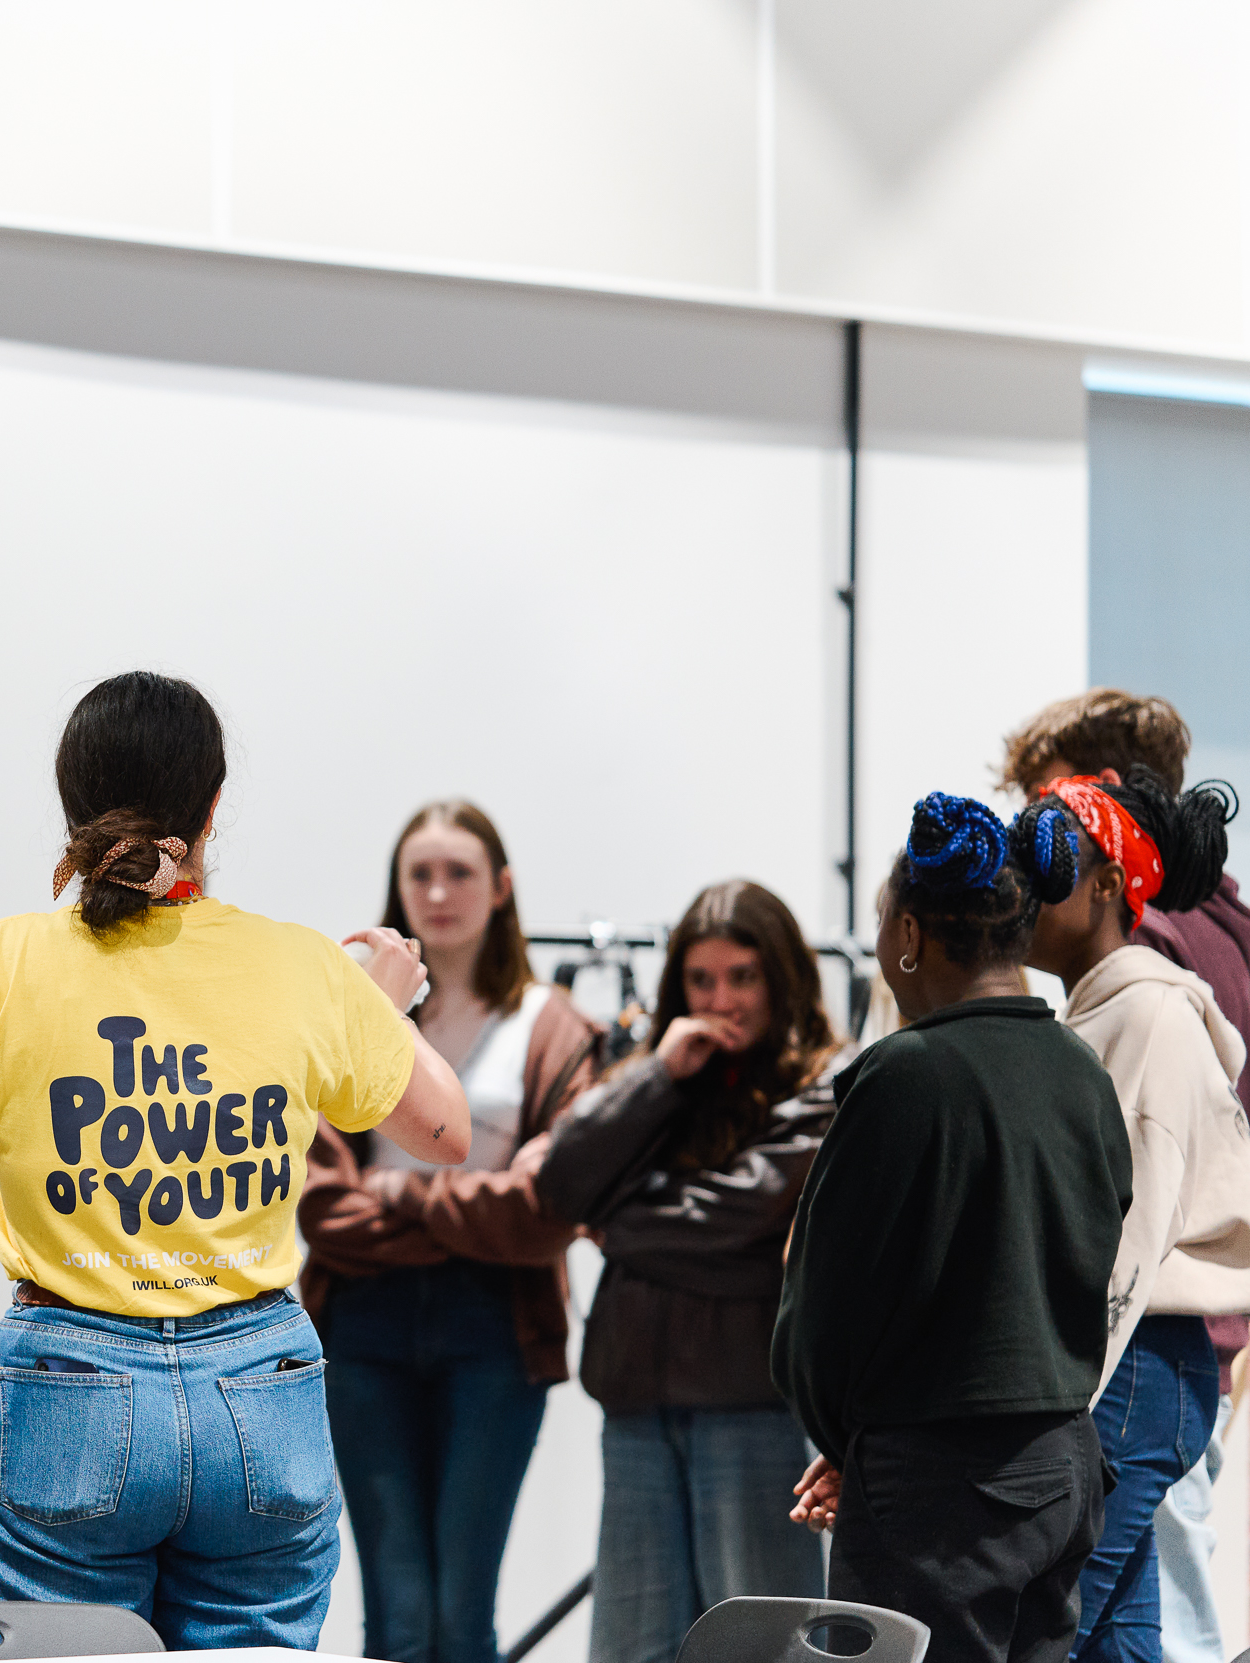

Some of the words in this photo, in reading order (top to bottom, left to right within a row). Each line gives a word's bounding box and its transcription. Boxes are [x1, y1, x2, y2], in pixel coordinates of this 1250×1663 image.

[97, 1016, 213, 1098] THE
[49, 1075, 288, 1169] POWER
[45, 1168, 99, 1215] OF
[103, 1153, 291, 1236] YOUTH
[61, 1251, 111, 1269] JOIN
[116, 1252, 161, 1270] THE
[162, 1244, 273, 1270] MOVEMENT
[132, 1275, 219, 1291] IWILL.ORG.UK
